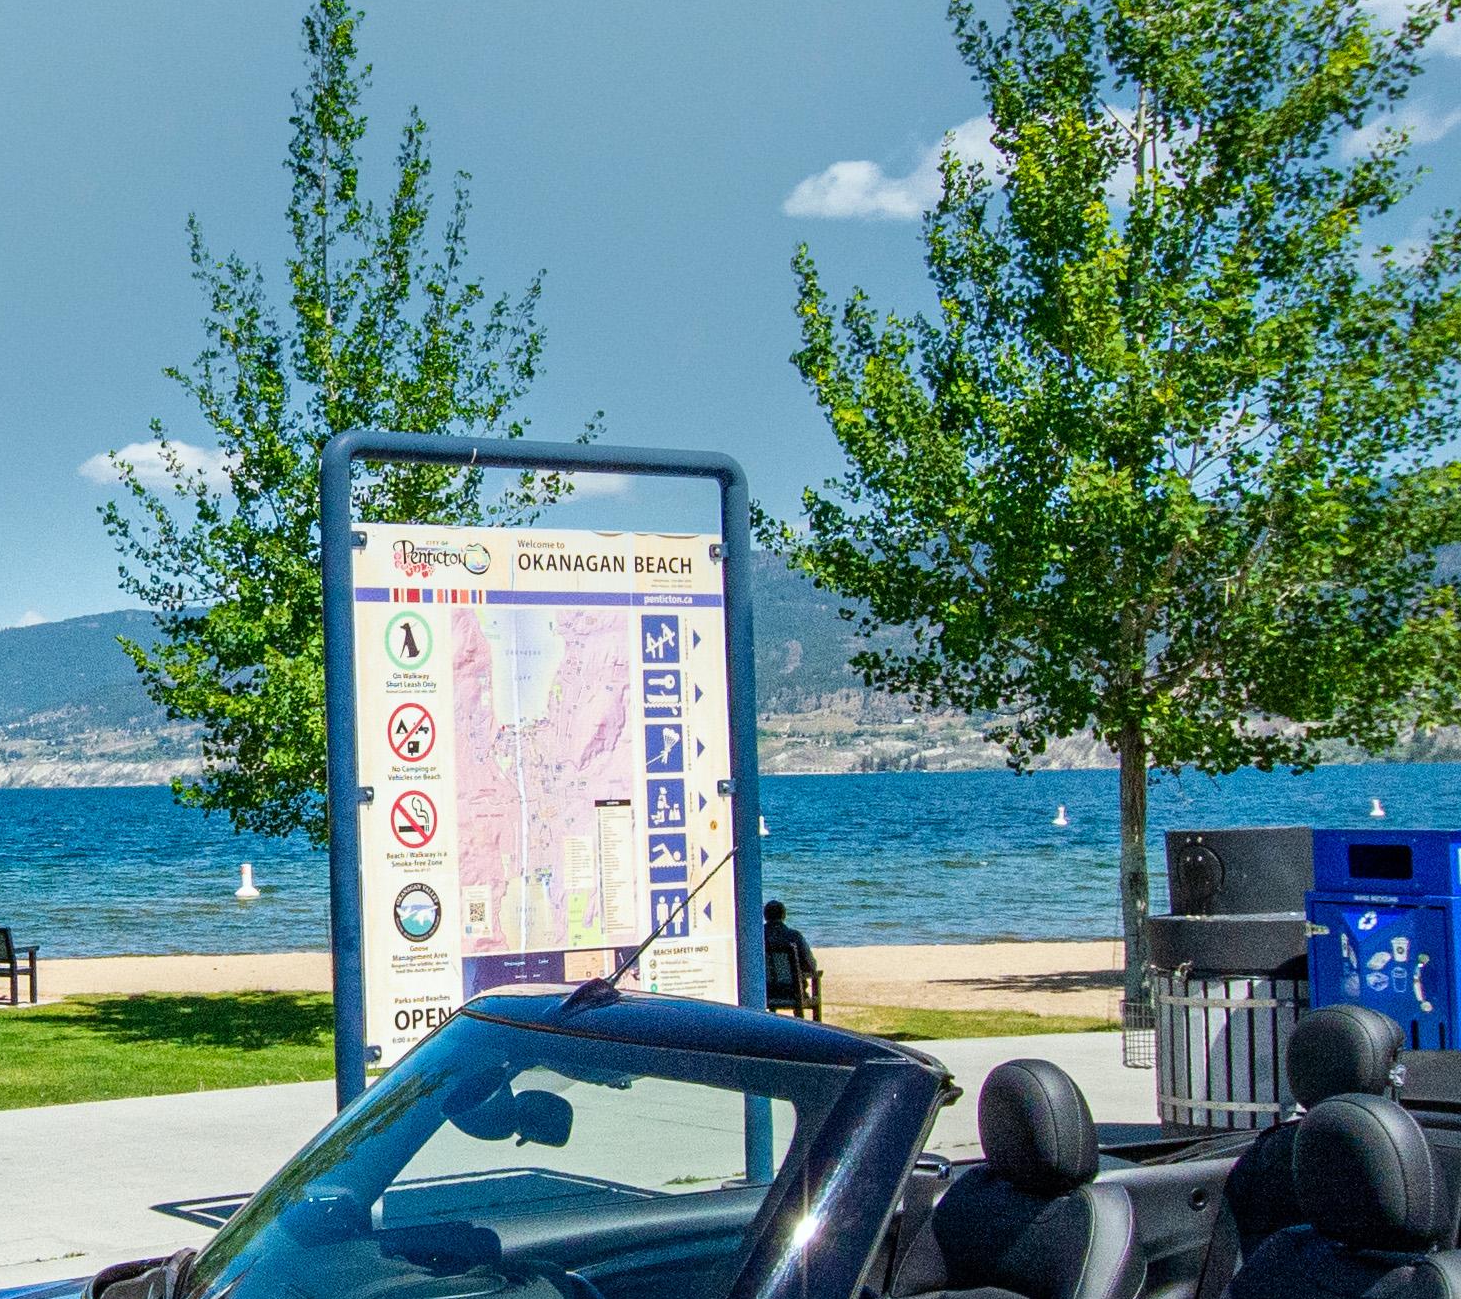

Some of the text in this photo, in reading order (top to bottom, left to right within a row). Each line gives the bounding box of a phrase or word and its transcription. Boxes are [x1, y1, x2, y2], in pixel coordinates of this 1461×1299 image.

[517, 539, 565, 550] Welcome to
[517, 552, 693, 575] OKANAGAN BEACH
[643, 593, 693, 606] penticton.ca
[403, 673, 430, 681] Walkway
[423, 681, 437, 689] Only
[401, 766, 429, 774] Camping
[410, 852, 437, 860] Walkway
[391, 860, 426, 868] Smoke-free
[653, 948, 672, 956] BEACH
[673, 946, 694, 954] SAFETY
[392, 953, 433, 961] Management
[425, 994, 451, 1002] Beaches
[394, 1006, 452, 1031] OPEN
